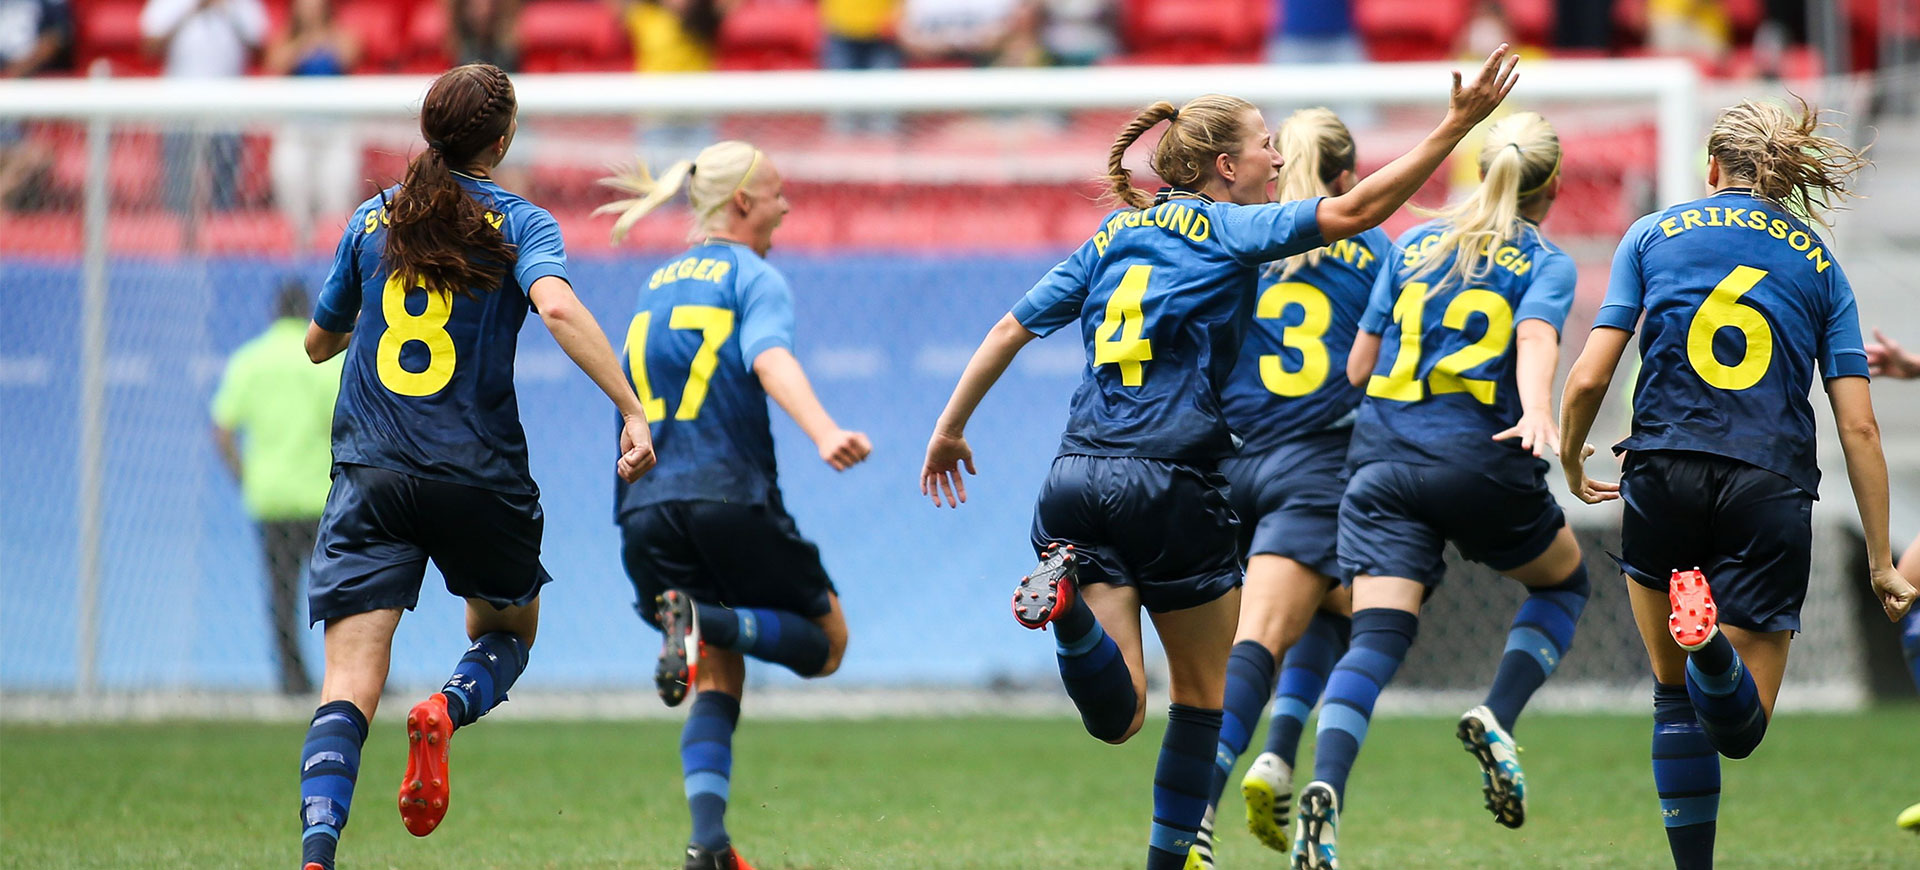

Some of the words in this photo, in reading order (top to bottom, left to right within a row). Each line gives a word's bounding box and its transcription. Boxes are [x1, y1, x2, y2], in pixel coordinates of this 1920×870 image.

[648, 257, 731, 290] SEGER
[1093, 202, 1210, 258] BERGLUND
[1659, 206, 1831, 274] ERIKSSON
[376, 268, 457, 397] 8
[623, 305, 734, 423] 17
[1093, 264, 1153, 387] 4
[1256, 281, 1331, 398] 3
[1365, 282, 1515, 405] 12
[1686, 264, 1774, 391] 6
